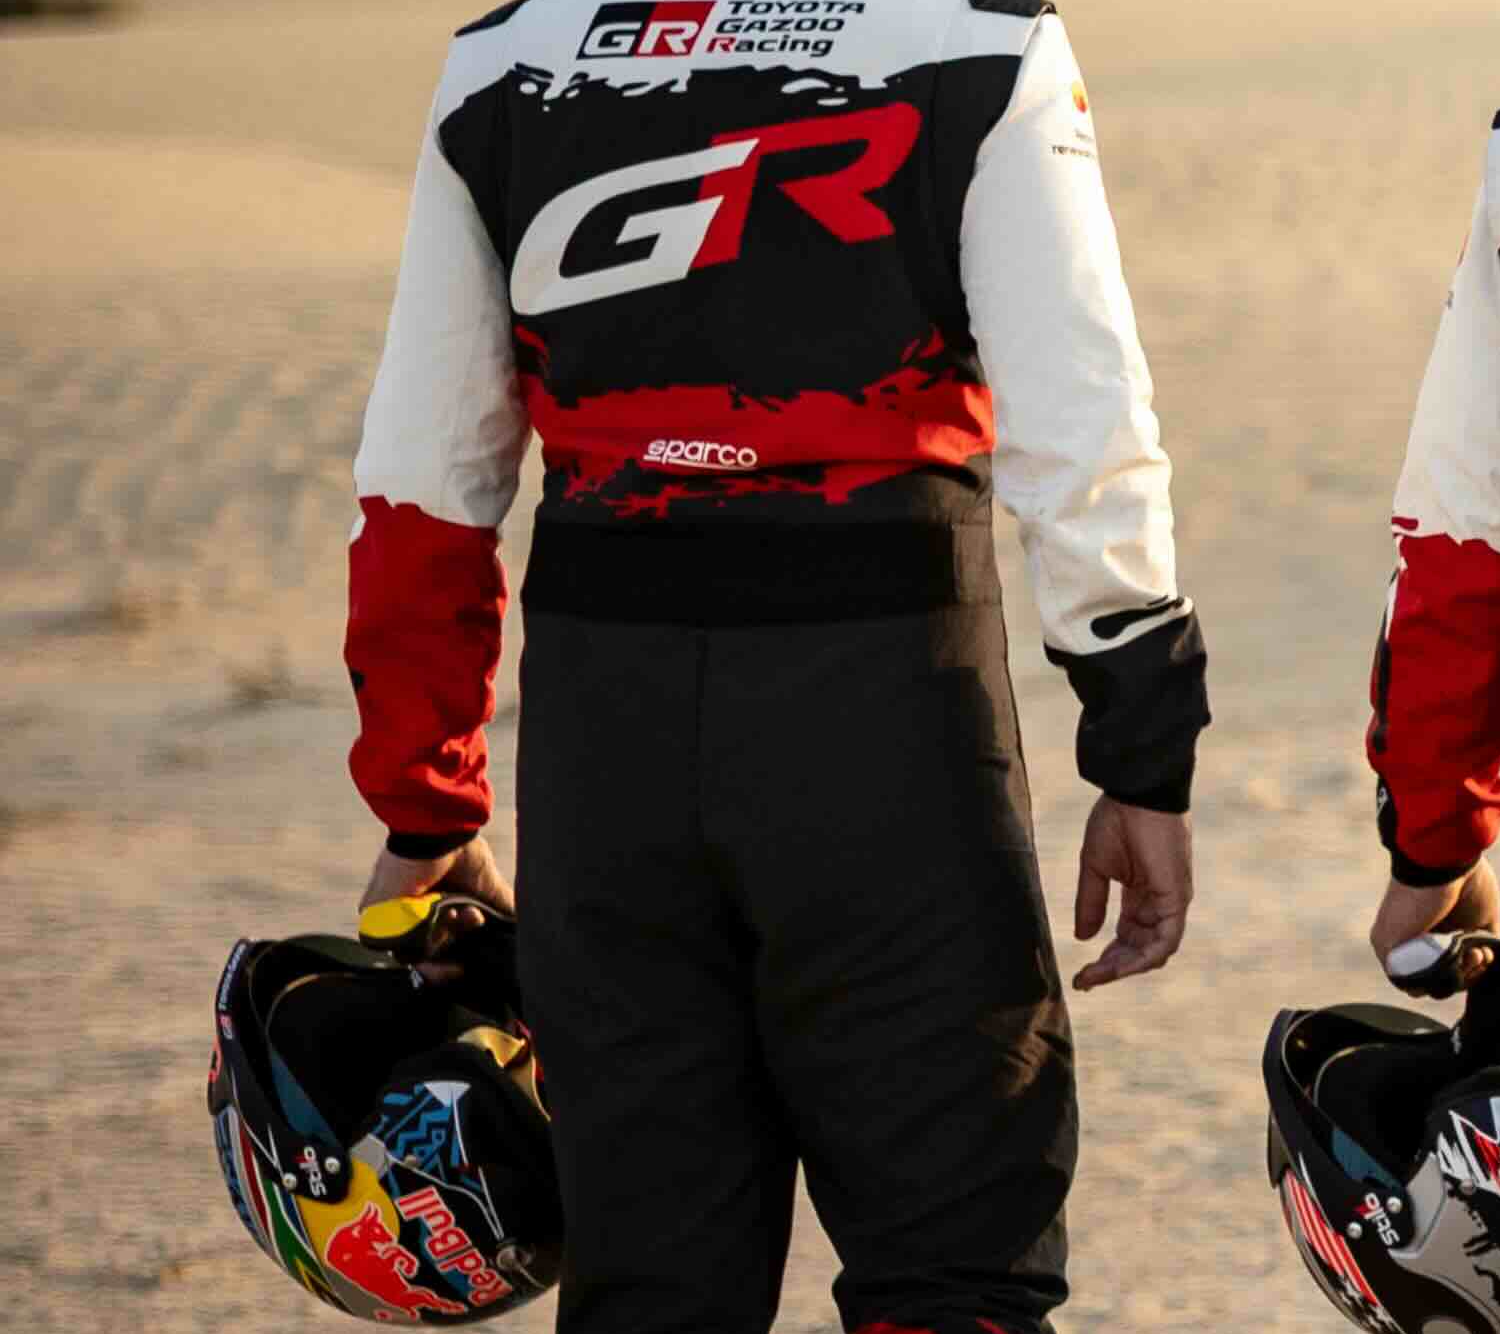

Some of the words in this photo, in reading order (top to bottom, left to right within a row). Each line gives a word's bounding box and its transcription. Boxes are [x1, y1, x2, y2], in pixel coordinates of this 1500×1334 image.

[727, 0, 866, 15] TOYOTA
[581, 21, 700, 56] GR
[716, 18, 844, 33] GAZOO
[705, 34, 835, 58] Racing
[510, 102, 921, 316] GR
[643, 438, 758, 469] sparco
[399, 1185, 478, 1272] Bull
[440, 1245, 513, 1307] Red
